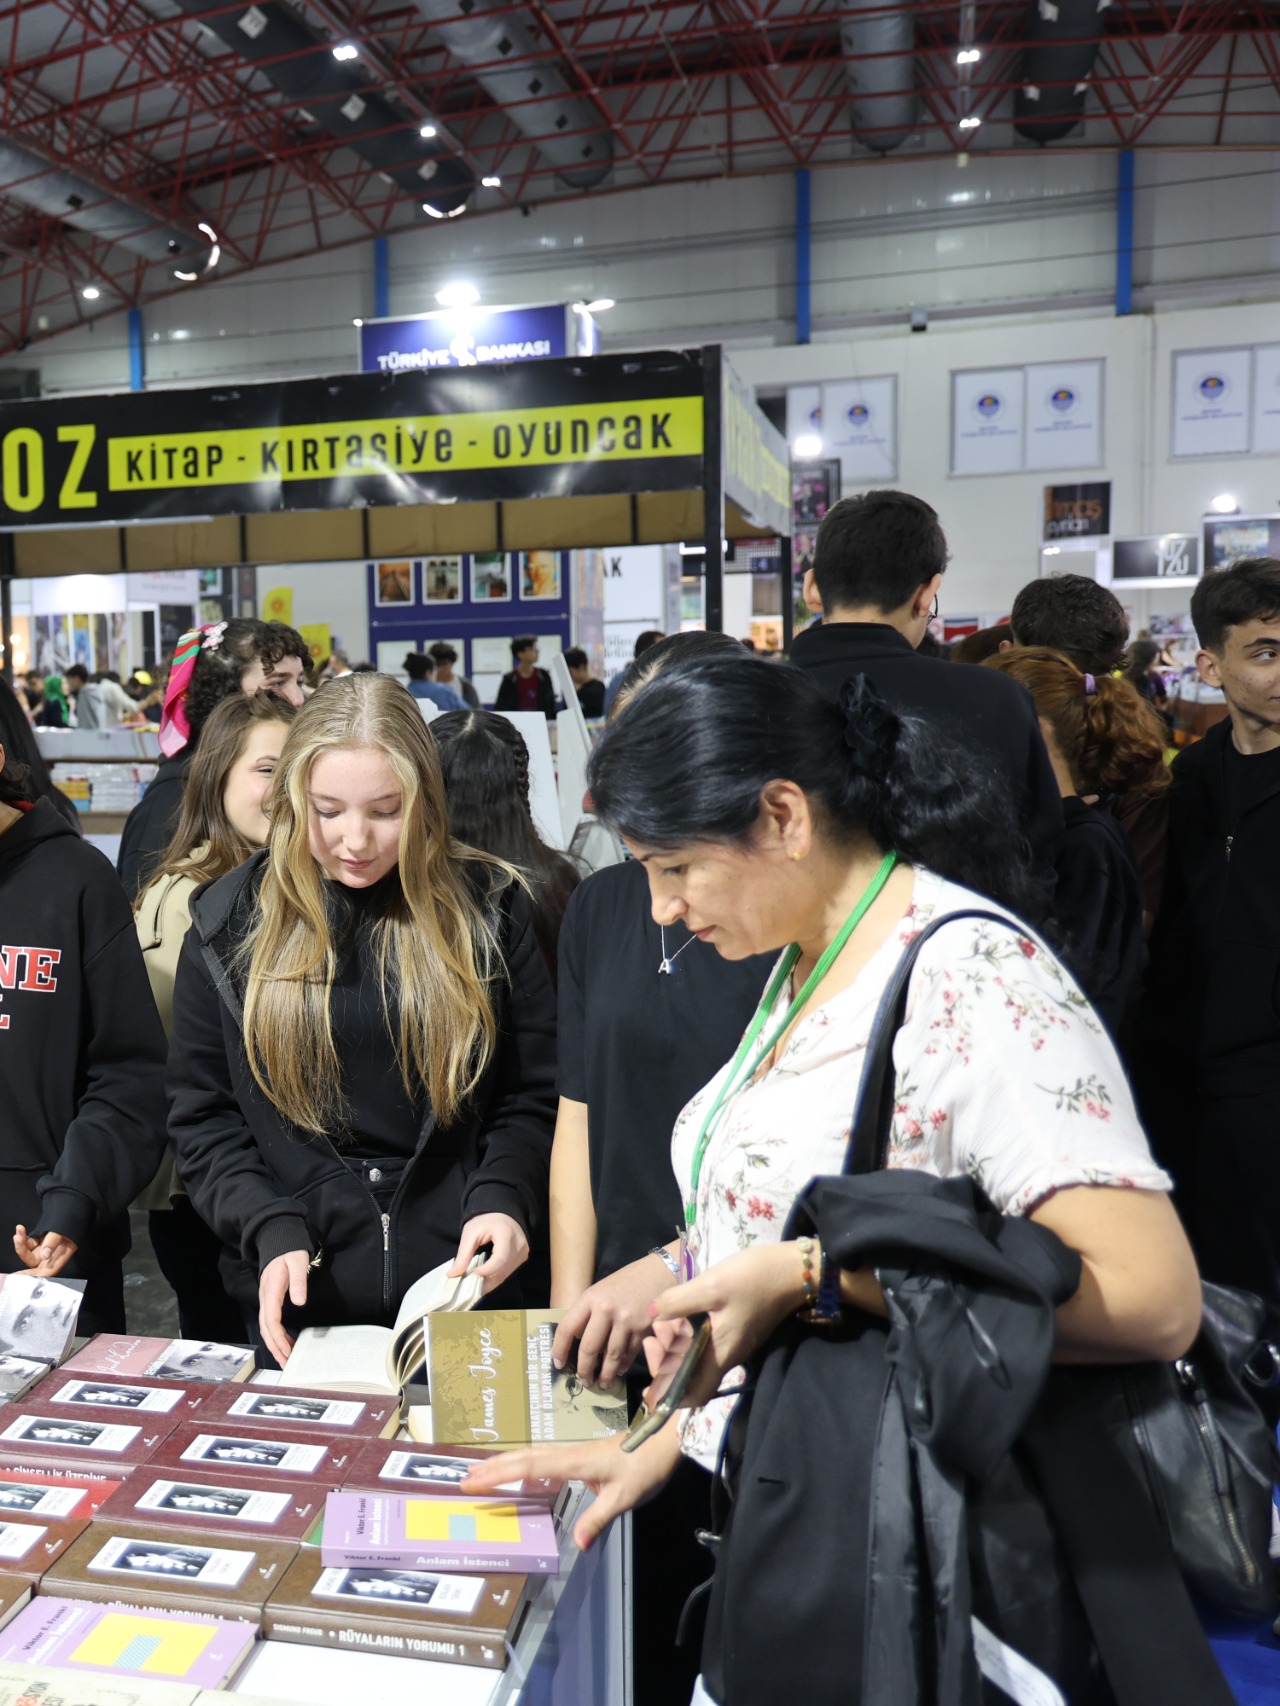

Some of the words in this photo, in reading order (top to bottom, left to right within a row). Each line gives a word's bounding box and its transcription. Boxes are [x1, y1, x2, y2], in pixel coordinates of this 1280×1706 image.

[377, 349, 450, 370] TÜRKİYE
[476, 340, 550, 361] BANKASI
[466, 1327, 502, 1379] Joyce
[526, 1336, 541, 1361] GENÇ
[537, 1324, 553, 1369] PORTRESİ
[526, 1364, 540, 1381] BİR
[540, 1379, 553, 1410] OLARAK
[469, 1386, 499, 1442] James
[528, 1383, 541, 1441] SANATÇININ
[543, 1412, 555, 1440] ADAM
[416, 1555, 460, 1567] Anlam
[463, 1555, 510, 1568] İstenci
[22, 1631, 45, 1651] Viktor
[47, 1605, 69, 1625] Frankl
[272, 1623, 302, 1635] SIGMUND
[302, 1627, 323, 1637] FREUD
[338, 1628, 405, 1650] RÜYALARIN
[405, 1638, 455, 1655] YORUMU
[458, 1644, 465, 1657] 1
